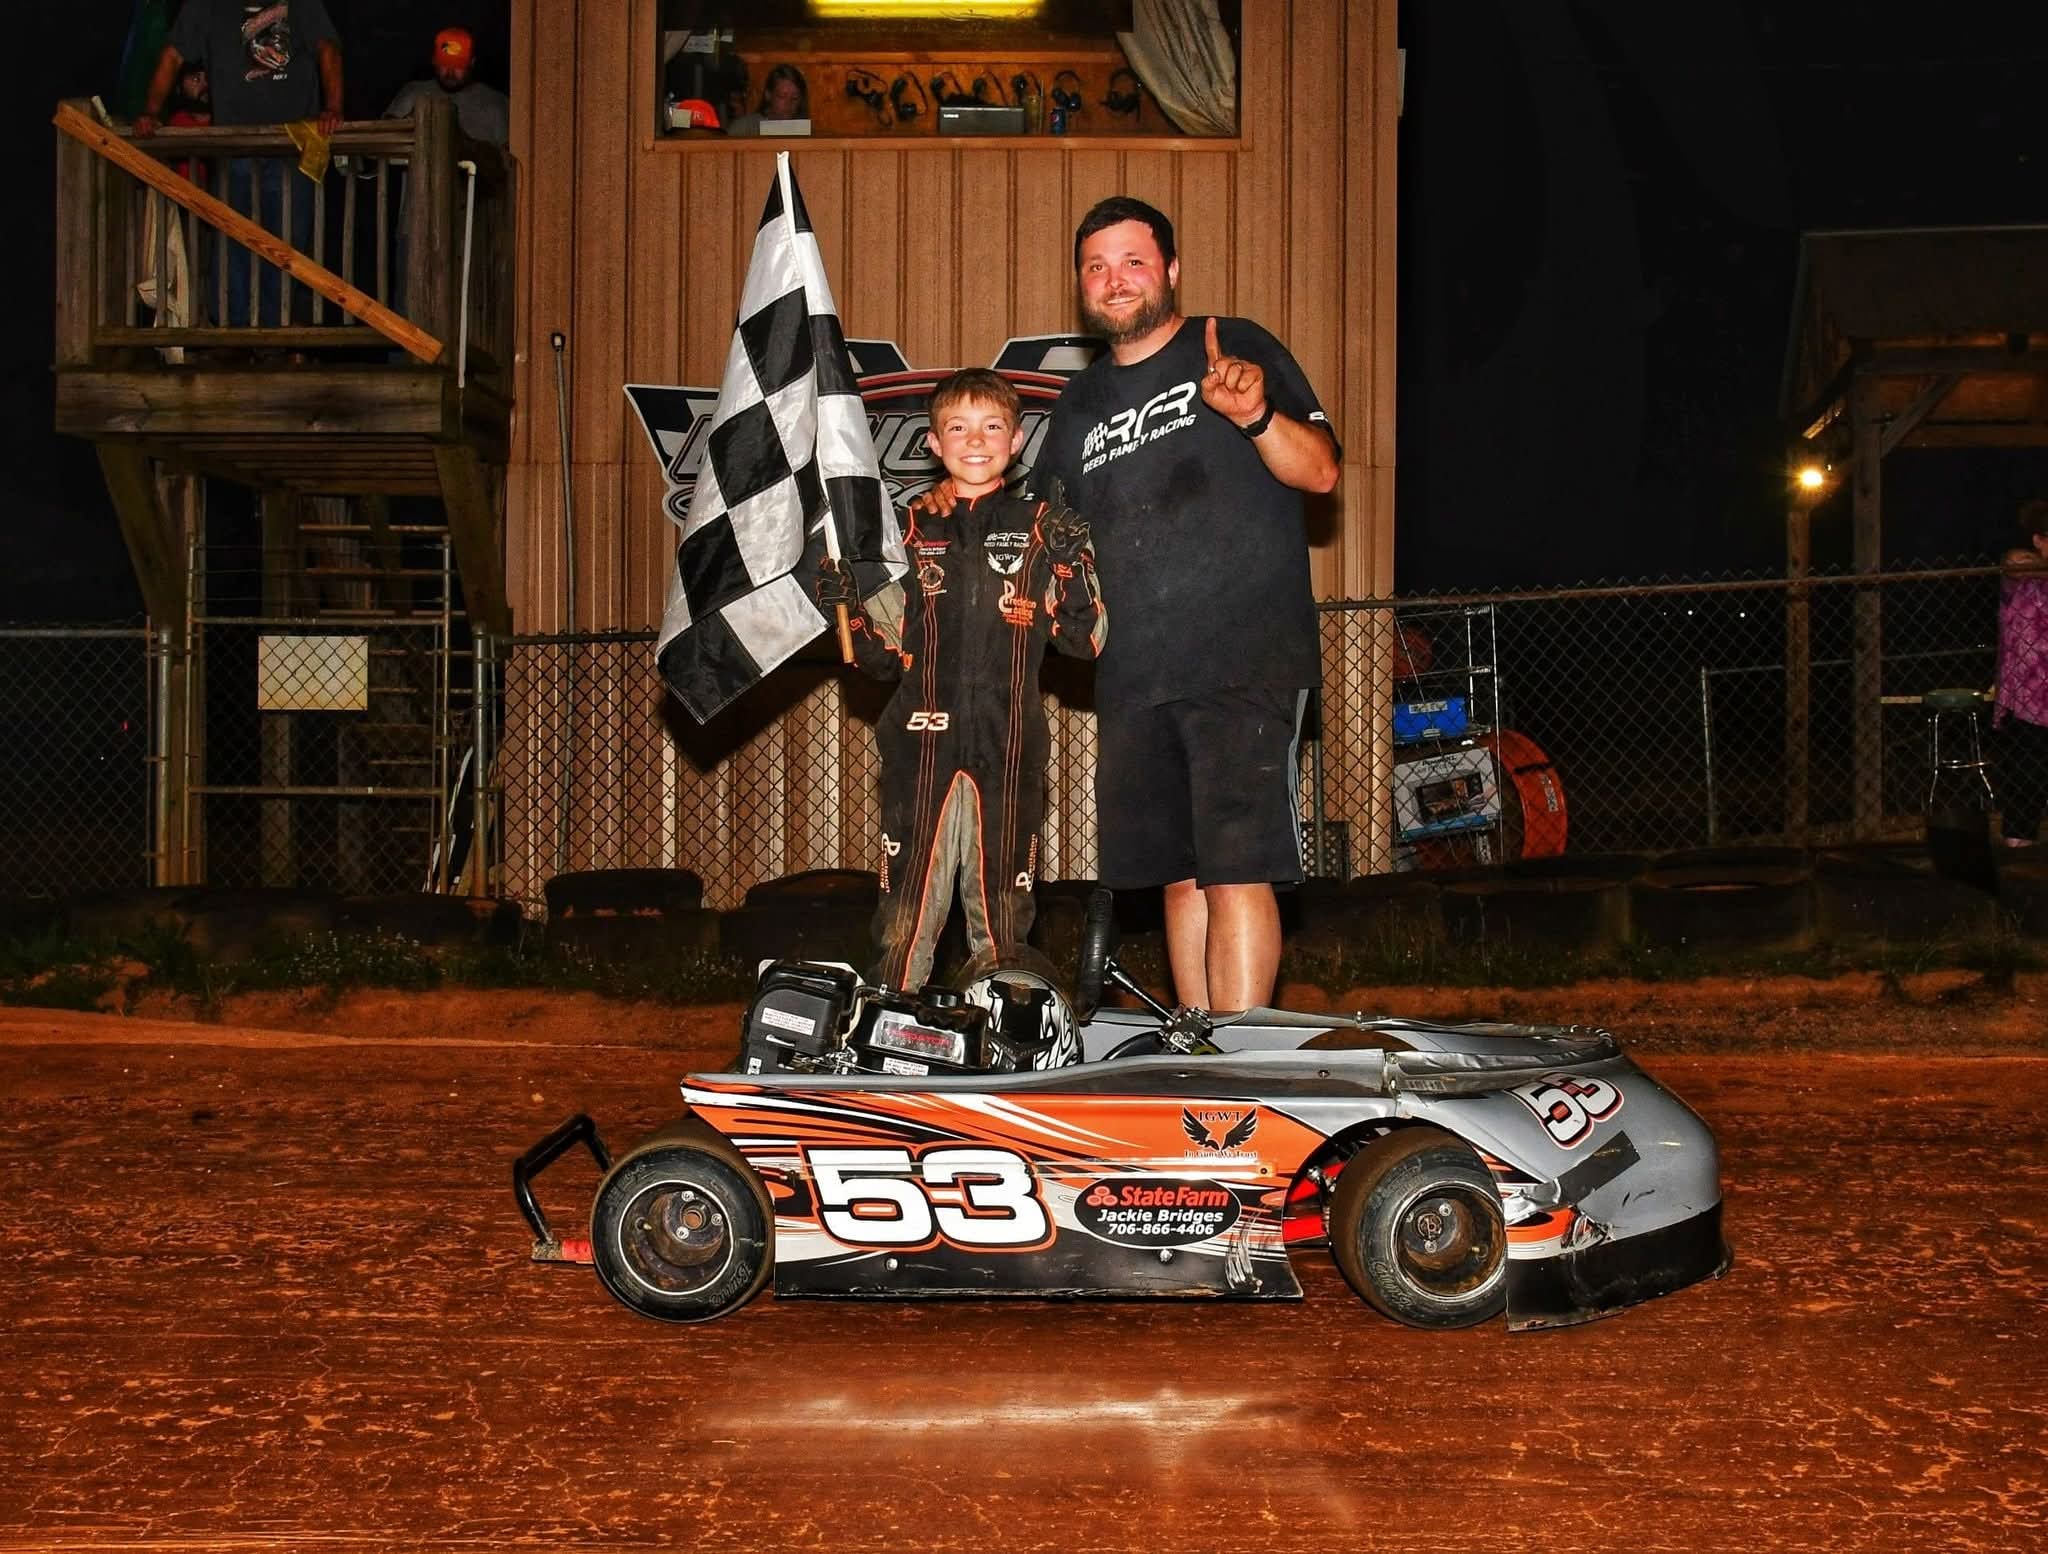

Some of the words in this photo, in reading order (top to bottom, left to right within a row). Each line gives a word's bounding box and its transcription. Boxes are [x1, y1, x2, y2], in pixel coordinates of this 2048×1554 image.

[1083, 453, 1107, 475] REED
[1150, 414, 1197, 441] RACING
[995, 553, 1018, 562] IGWT
[906, 711, 950, 731] 53
[1199, 1111, 1242, 1122] IGWT
[1506, 1072, 1621, 1146] 53
[803, 1146, 1050, 1247] 53
[1097, 1209, 1155, 1222] Jackie
[1157, 1209, 1224, 1225] Bridges
[1107, 1223, 1215, 1235] 706-866-4406
